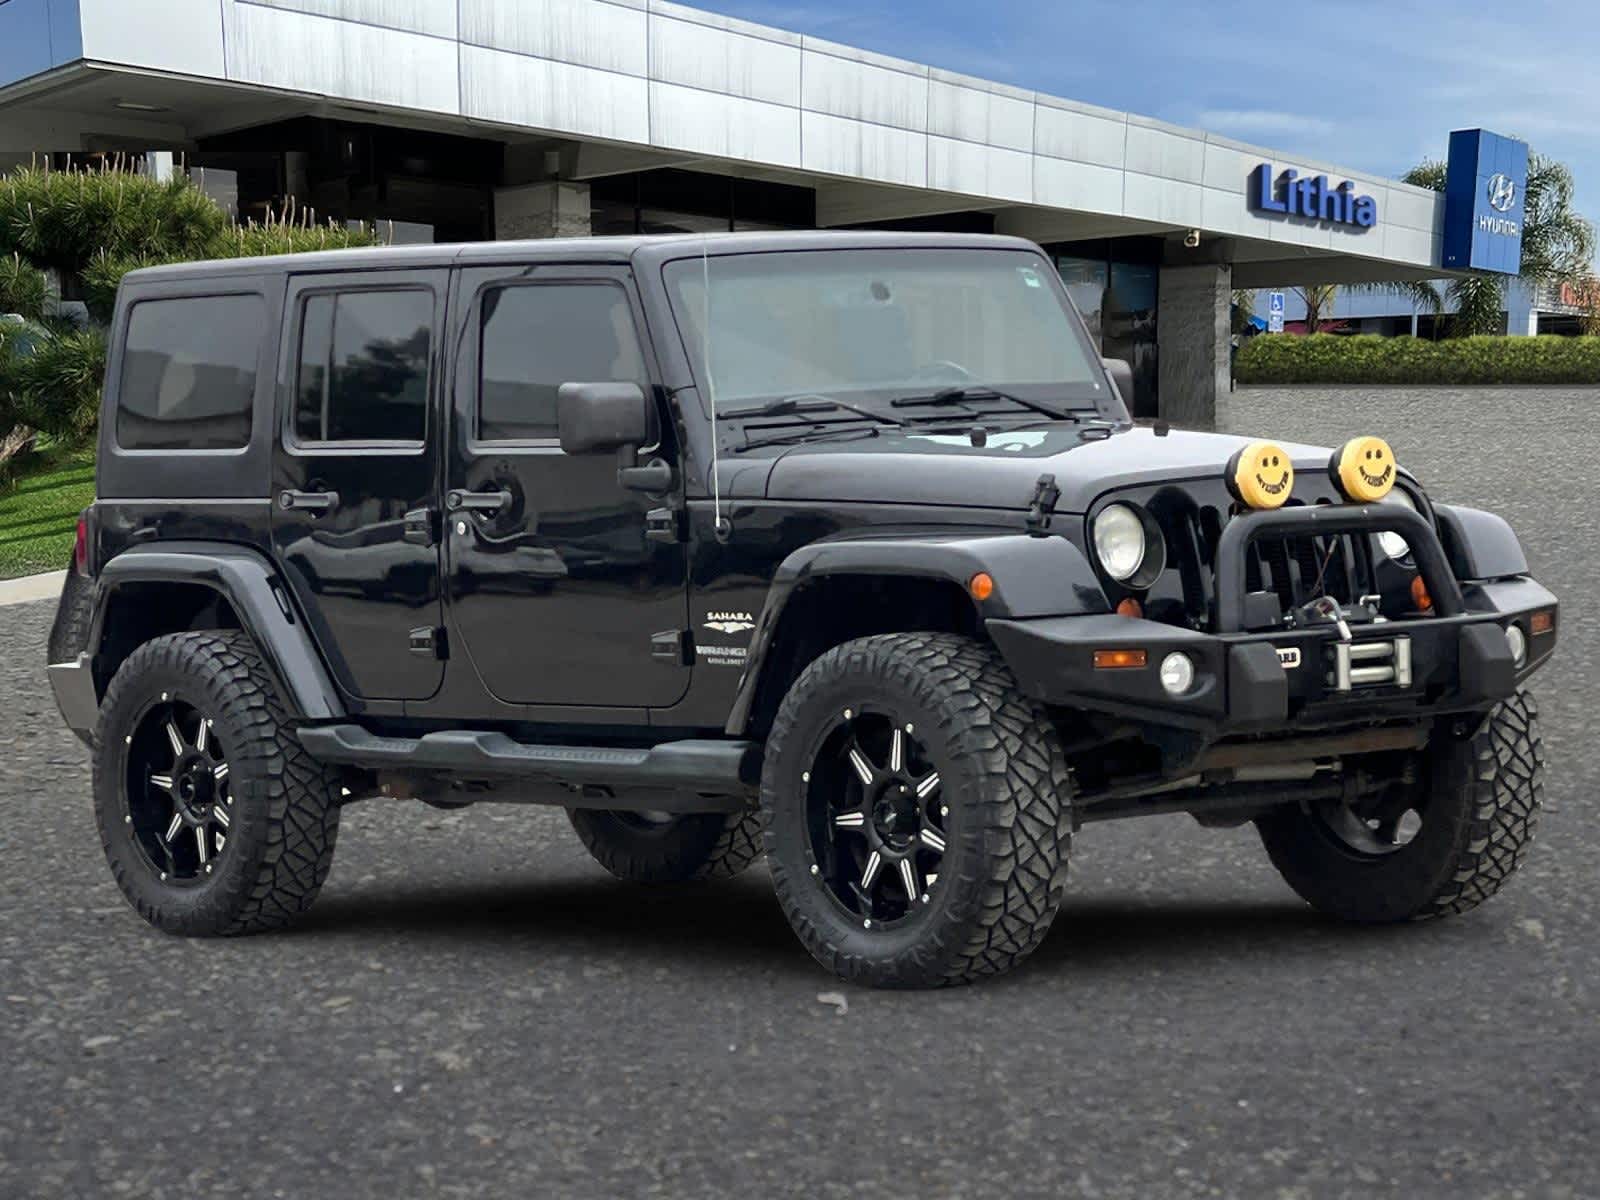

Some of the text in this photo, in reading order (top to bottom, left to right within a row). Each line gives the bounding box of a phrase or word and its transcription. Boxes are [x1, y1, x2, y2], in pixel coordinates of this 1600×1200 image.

[1255, 163, 1377, 230] Lithia
[1479, 215, 1520, 238] HYUNDAI
[707, 612, 753, 621] SAHARA
